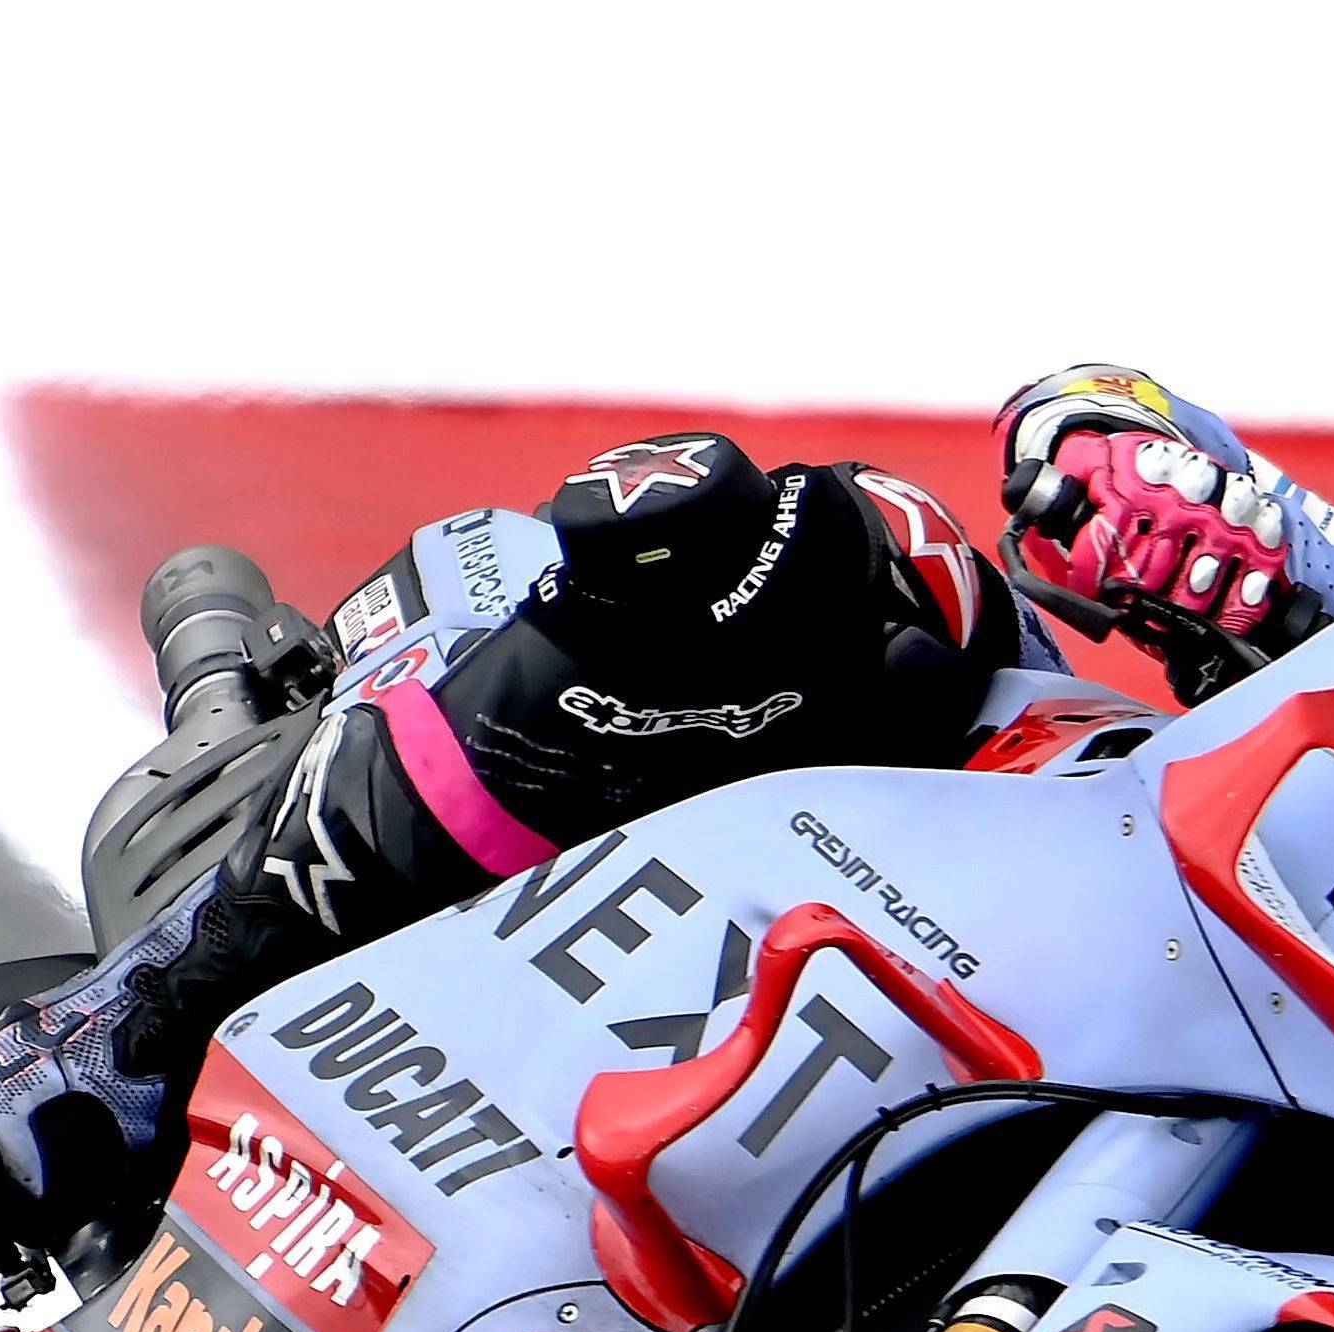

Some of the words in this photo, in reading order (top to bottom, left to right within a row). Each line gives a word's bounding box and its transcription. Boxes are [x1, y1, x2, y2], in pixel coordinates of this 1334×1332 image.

[710, 541, 782, 624] RACING
[790, 809, 882, 894] GRESINI
[879, 882, 981, 980] RACING
[269, 981, 545, 1198] DUCATI
